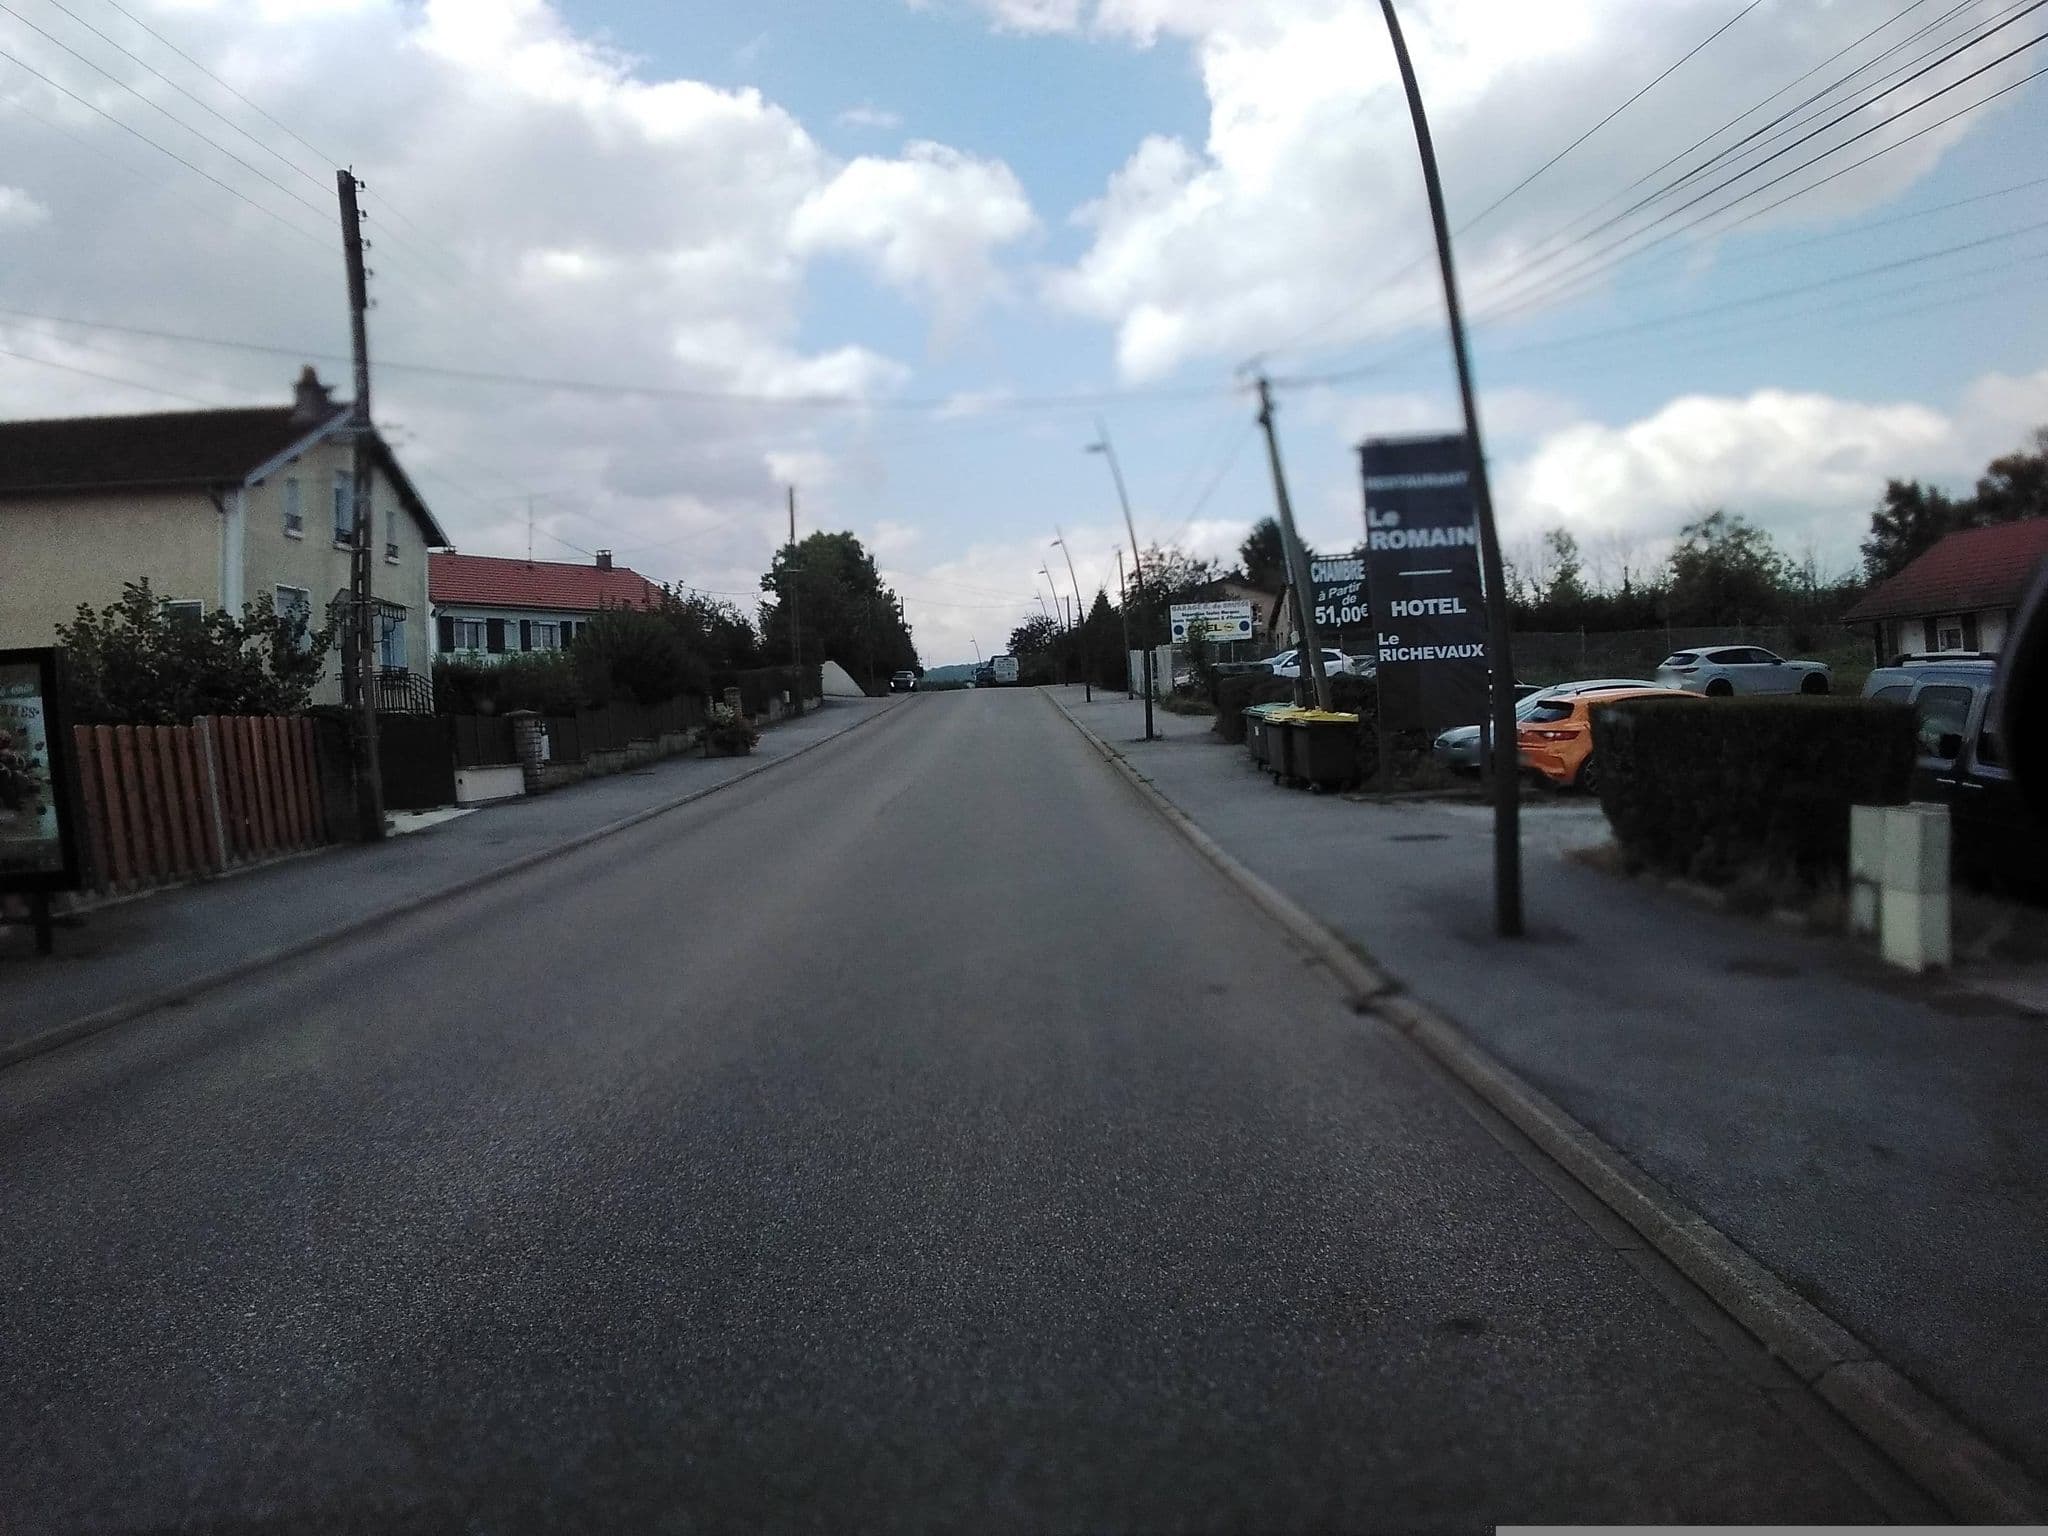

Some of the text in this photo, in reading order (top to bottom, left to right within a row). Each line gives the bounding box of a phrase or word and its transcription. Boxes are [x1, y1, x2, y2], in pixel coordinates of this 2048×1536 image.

[1367, 506, 1400, 527] Le
[1370, 527, 1475, 550] ROMAIN
[1328, 582, 1362, 599] Partir
[1341, 594, 1357, 606] de
[1315, 603, 1369, 627] 51,00€
[1391, 598, 1467, 617] HOTEL
[1378, 632, 1400, 646] Le
[1379, 643, 1485, 662] RICHEVAUX
